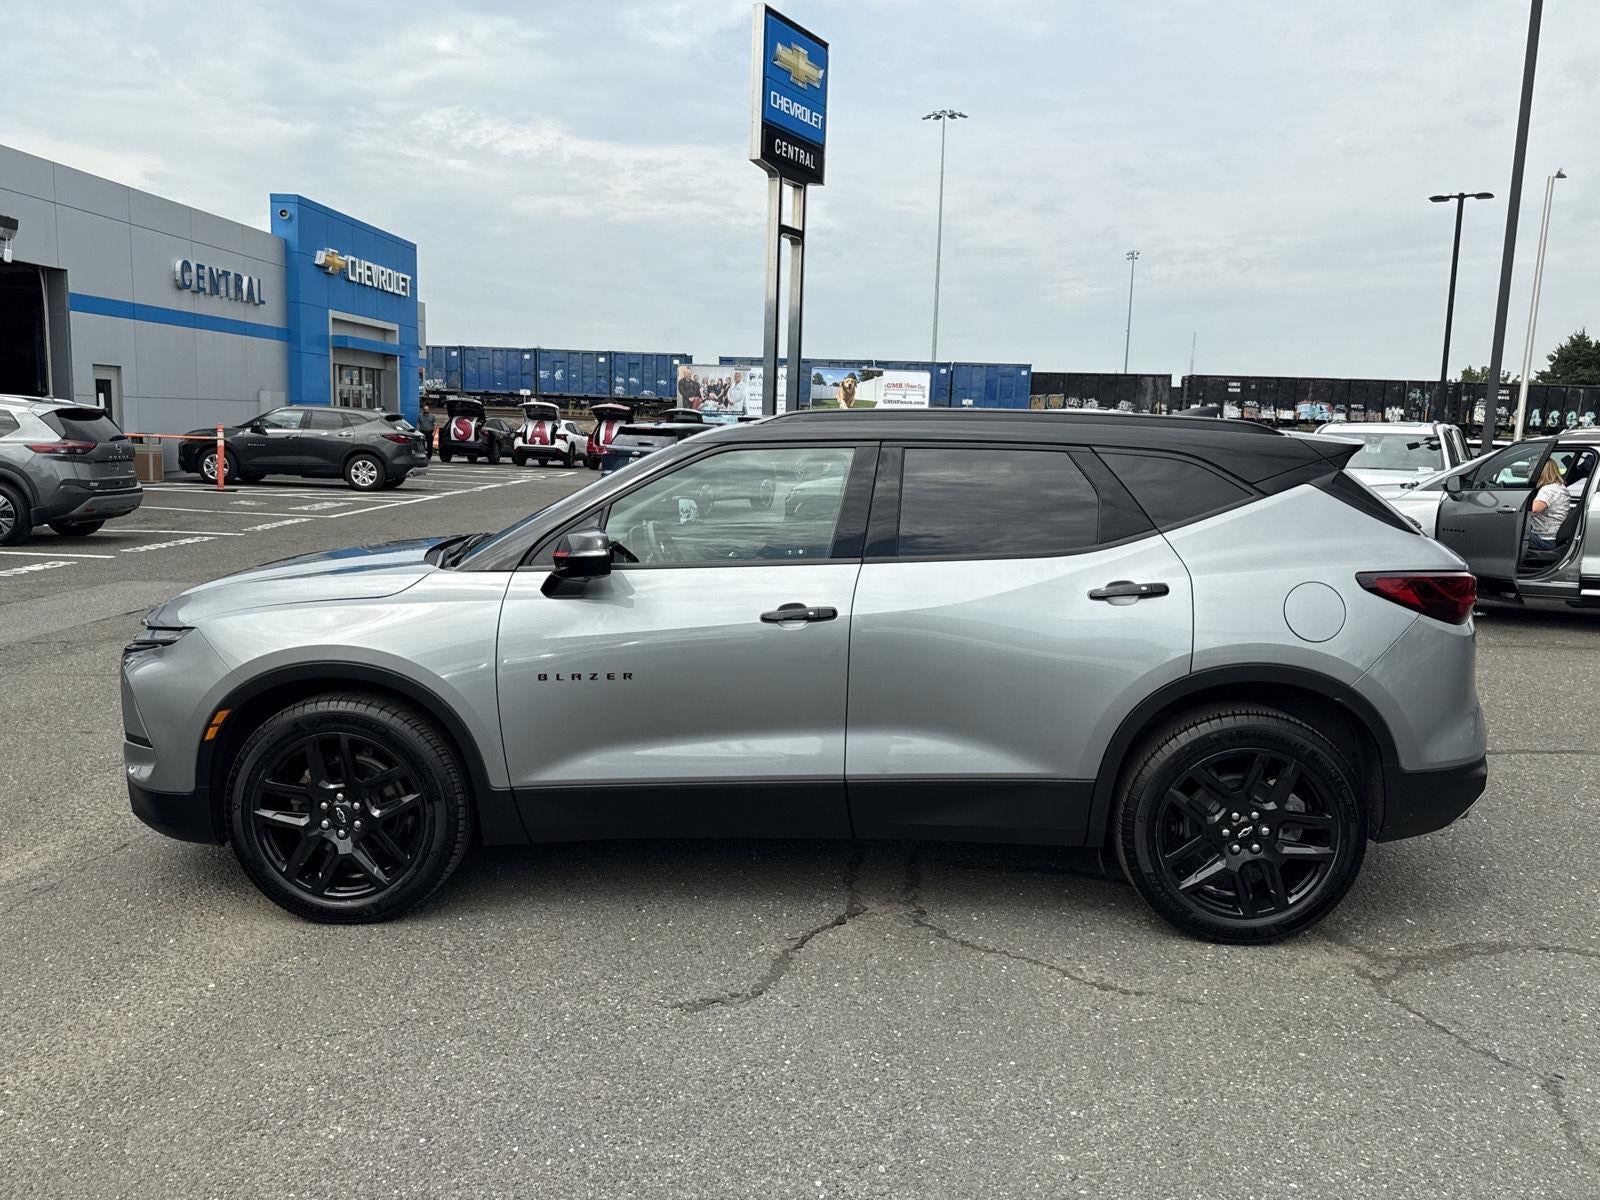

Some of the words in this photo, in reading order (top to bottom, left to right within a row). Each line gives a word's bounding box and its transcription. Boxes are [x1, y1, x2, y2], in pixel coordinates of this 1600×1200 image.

[770, 90, 823, 130] CHEVROLET
[774, 138, 816, 170] CENTRAL
[175, 259, 266, 305] CENTRAL
[347, 254, 412, 298] CHEVROLET
[453, 416, 473, 442] S
[528, 420, 550, 445] A
[537, 672, 633, 681] BLAZER
